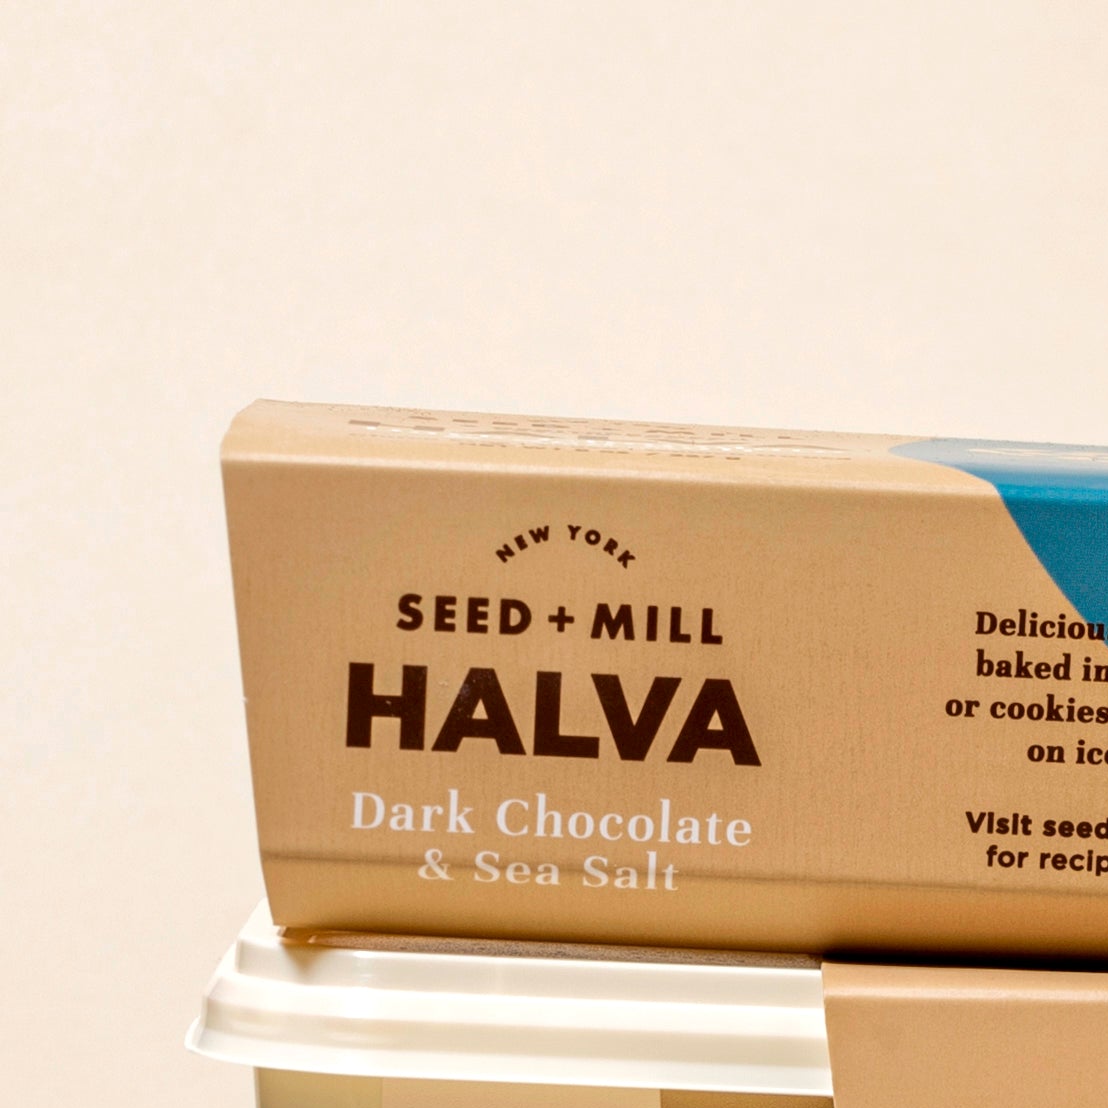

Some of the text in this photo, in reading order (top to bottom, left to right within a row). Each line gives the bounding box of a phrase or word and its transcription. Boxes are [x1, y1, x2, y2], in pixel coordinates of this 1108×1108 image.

[496, 525, 635, 568] NEW YORK
[397, 594, 722, 644] SEED + MILL
[977, 649, 1071, 680] baked
[346, 663, 761, 766] HALVA
[946, 699, 980, 717] or
[1028, 745, 1065, 763] on
[352, 789, 751, 846] Dark Chocolate
[966, 812, 1032, 835] Visit
[418, 848, 676, 890] & Sea Salt
[987, 845, 1028, 868] for
